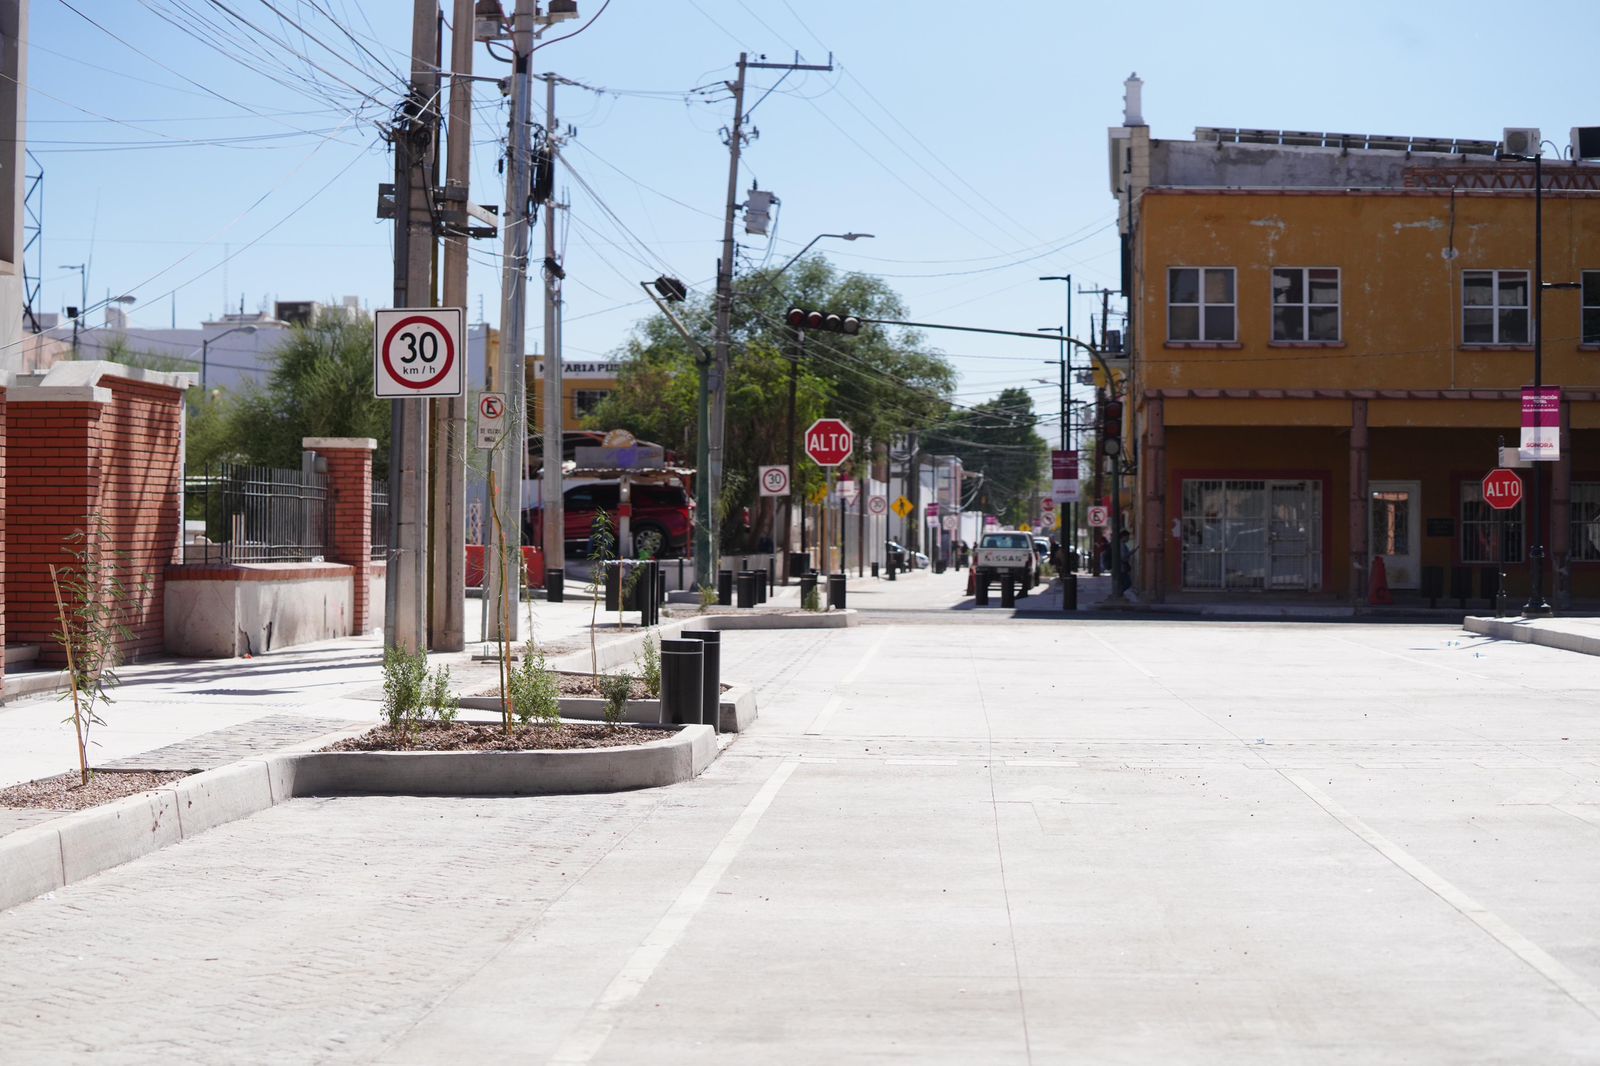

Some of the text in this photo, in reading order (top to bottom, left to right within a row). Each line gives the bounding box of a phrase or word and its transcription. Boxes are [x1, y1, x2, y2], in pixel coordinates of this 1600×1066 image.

[399, 331, 438, 363] 30
[809, 433, 849, 451] ALTO
[768, 473, 781, 484] 30
[1486, 481, 1519, 497] ALTO
